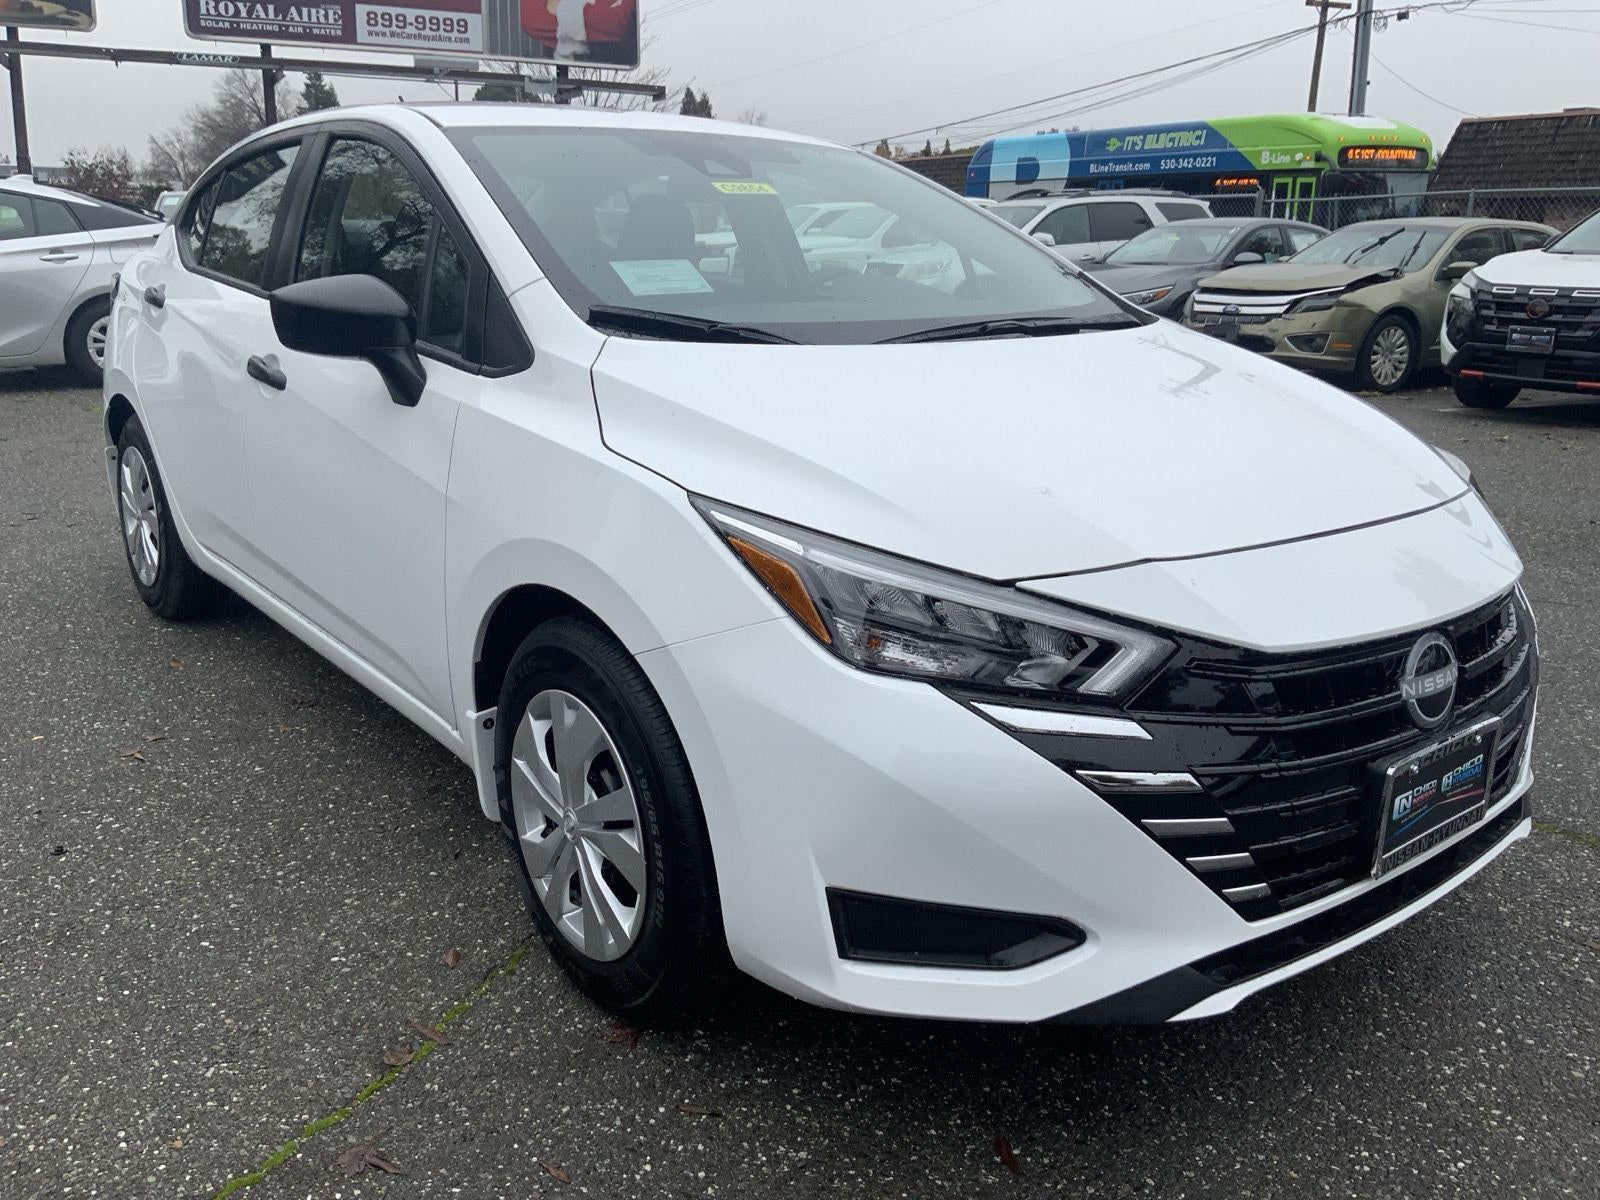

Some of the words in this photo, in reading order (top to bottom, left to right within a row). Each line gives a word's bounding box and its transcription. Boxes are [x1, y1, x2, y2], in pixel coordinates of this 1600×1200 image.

[199, 0, 282, 20] ROYAL
[286, 6, 343, 25] AIRE
[200, 19, 231, 29] SOLAR
[240, 22, 279, 32] HEATING
[288, 26, 304, 34] AIR
[312, 28, 342, 36] WATER
[366, 11, 469, 34] 899-9999
[367, 30, 470, 44] www.WeCareRoyalAire.com
[182, 53, 233, 63] LAMAR
[1123, 135, 1143, 151] IT'S
[1089, 162, 1151, 174] BLineTransit.com
[1160, 156, 1217, 170] 530-342-0221
[1261, 150, 1291, 164] B-Line
[1401, 666, 1458, 698] NISSAN
[1453, 754, 1484, 775] CHICO
[1413, 780, 1438, 796] CHICO
